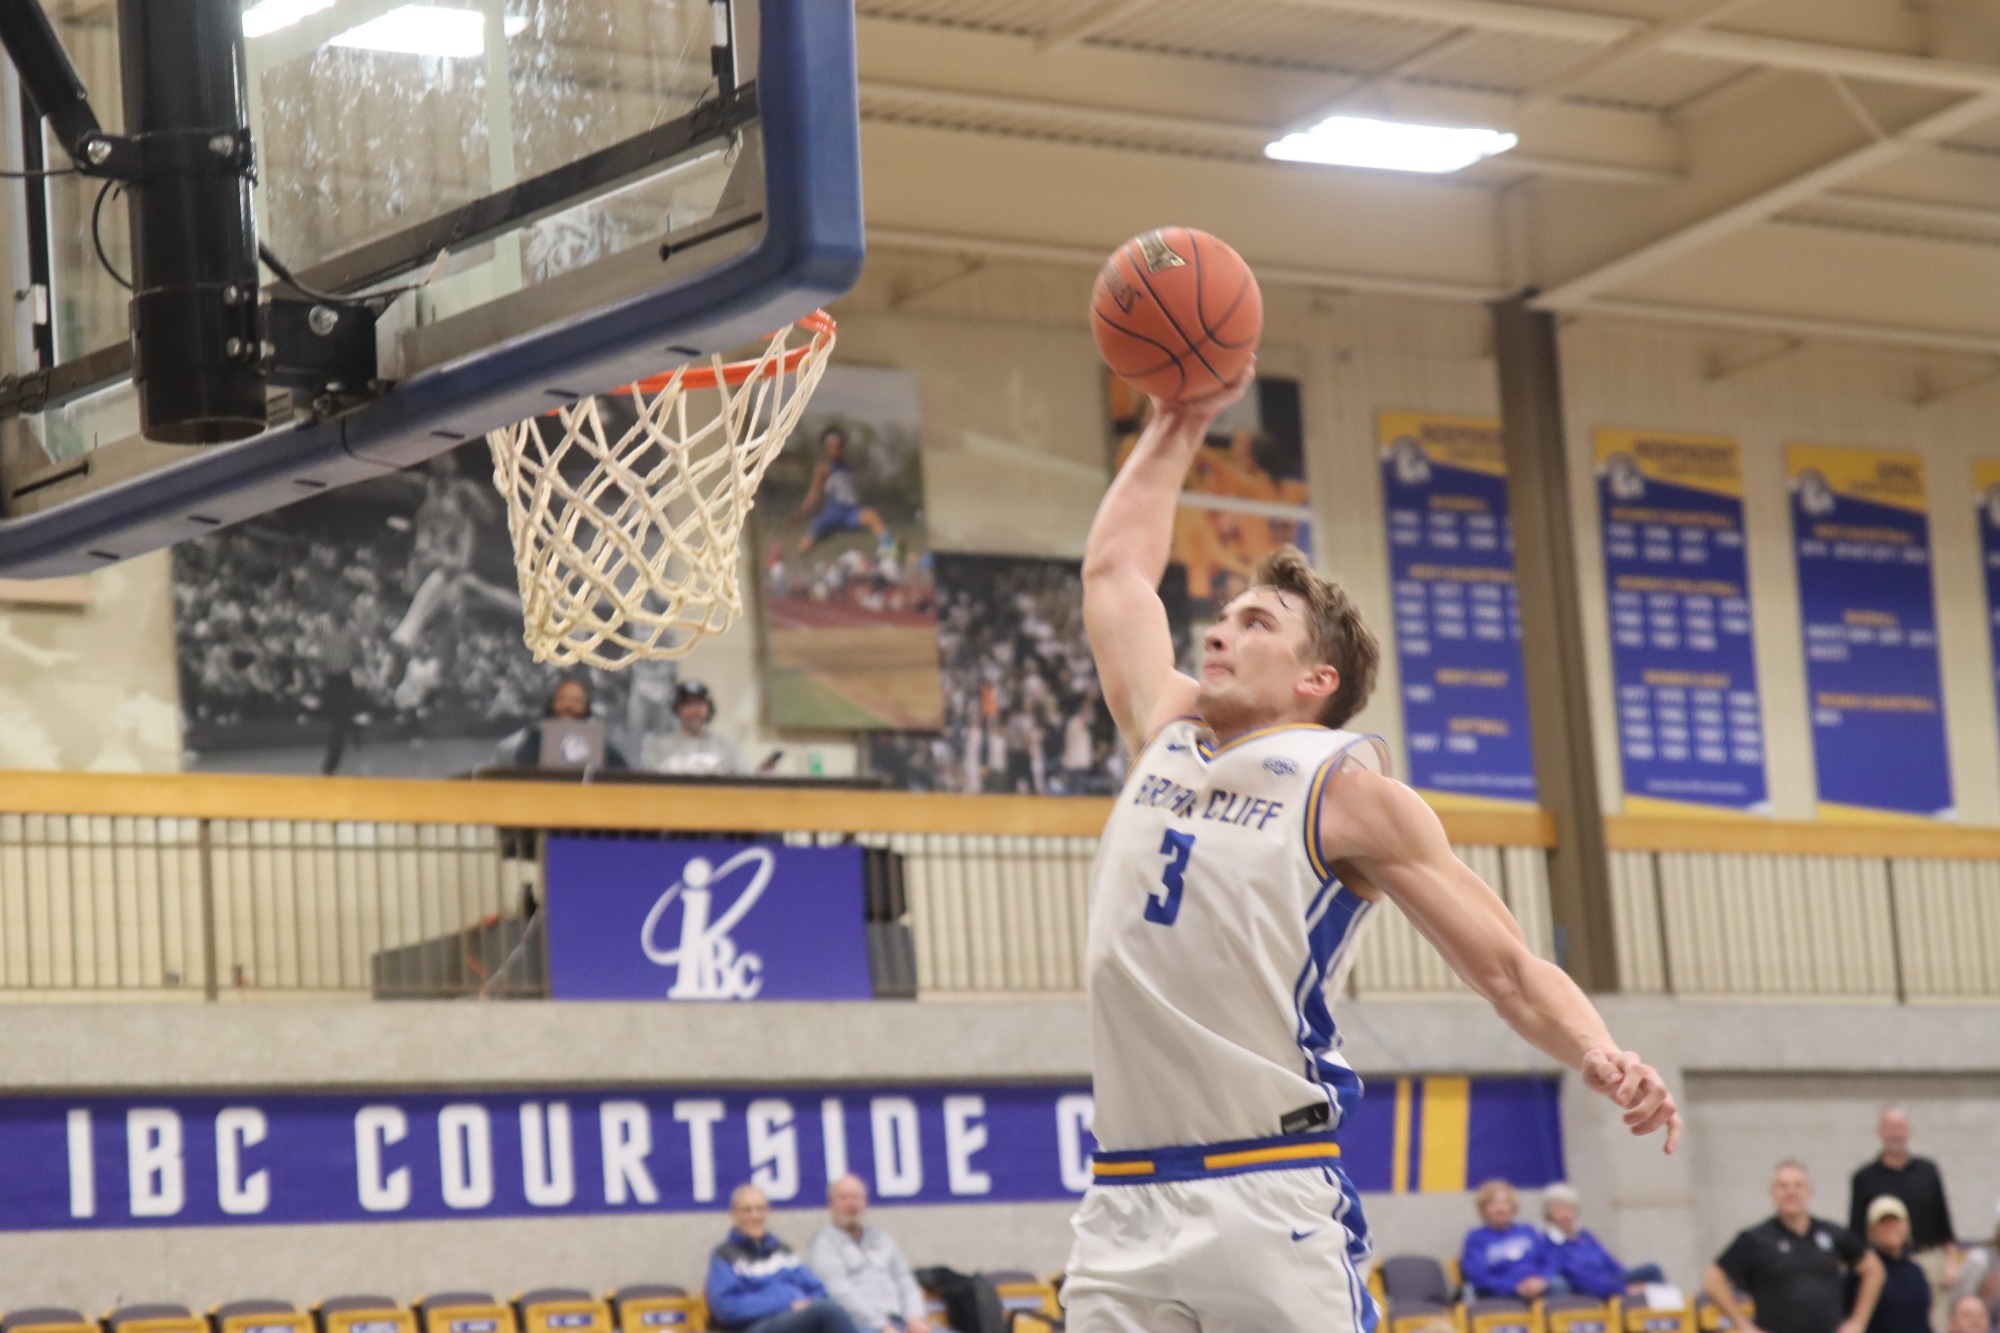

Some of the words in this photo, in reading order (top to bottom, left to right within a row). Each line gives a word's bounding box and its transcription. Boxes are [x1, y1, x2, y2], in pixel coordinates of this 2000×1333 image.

[1202, 788, 1283, 830] CLIFF
[1144, 828, 1196, 927] 3
[67, 1106, 270, 1218] IBC
[354, 1094, 992, 1212] COURTSIDE
